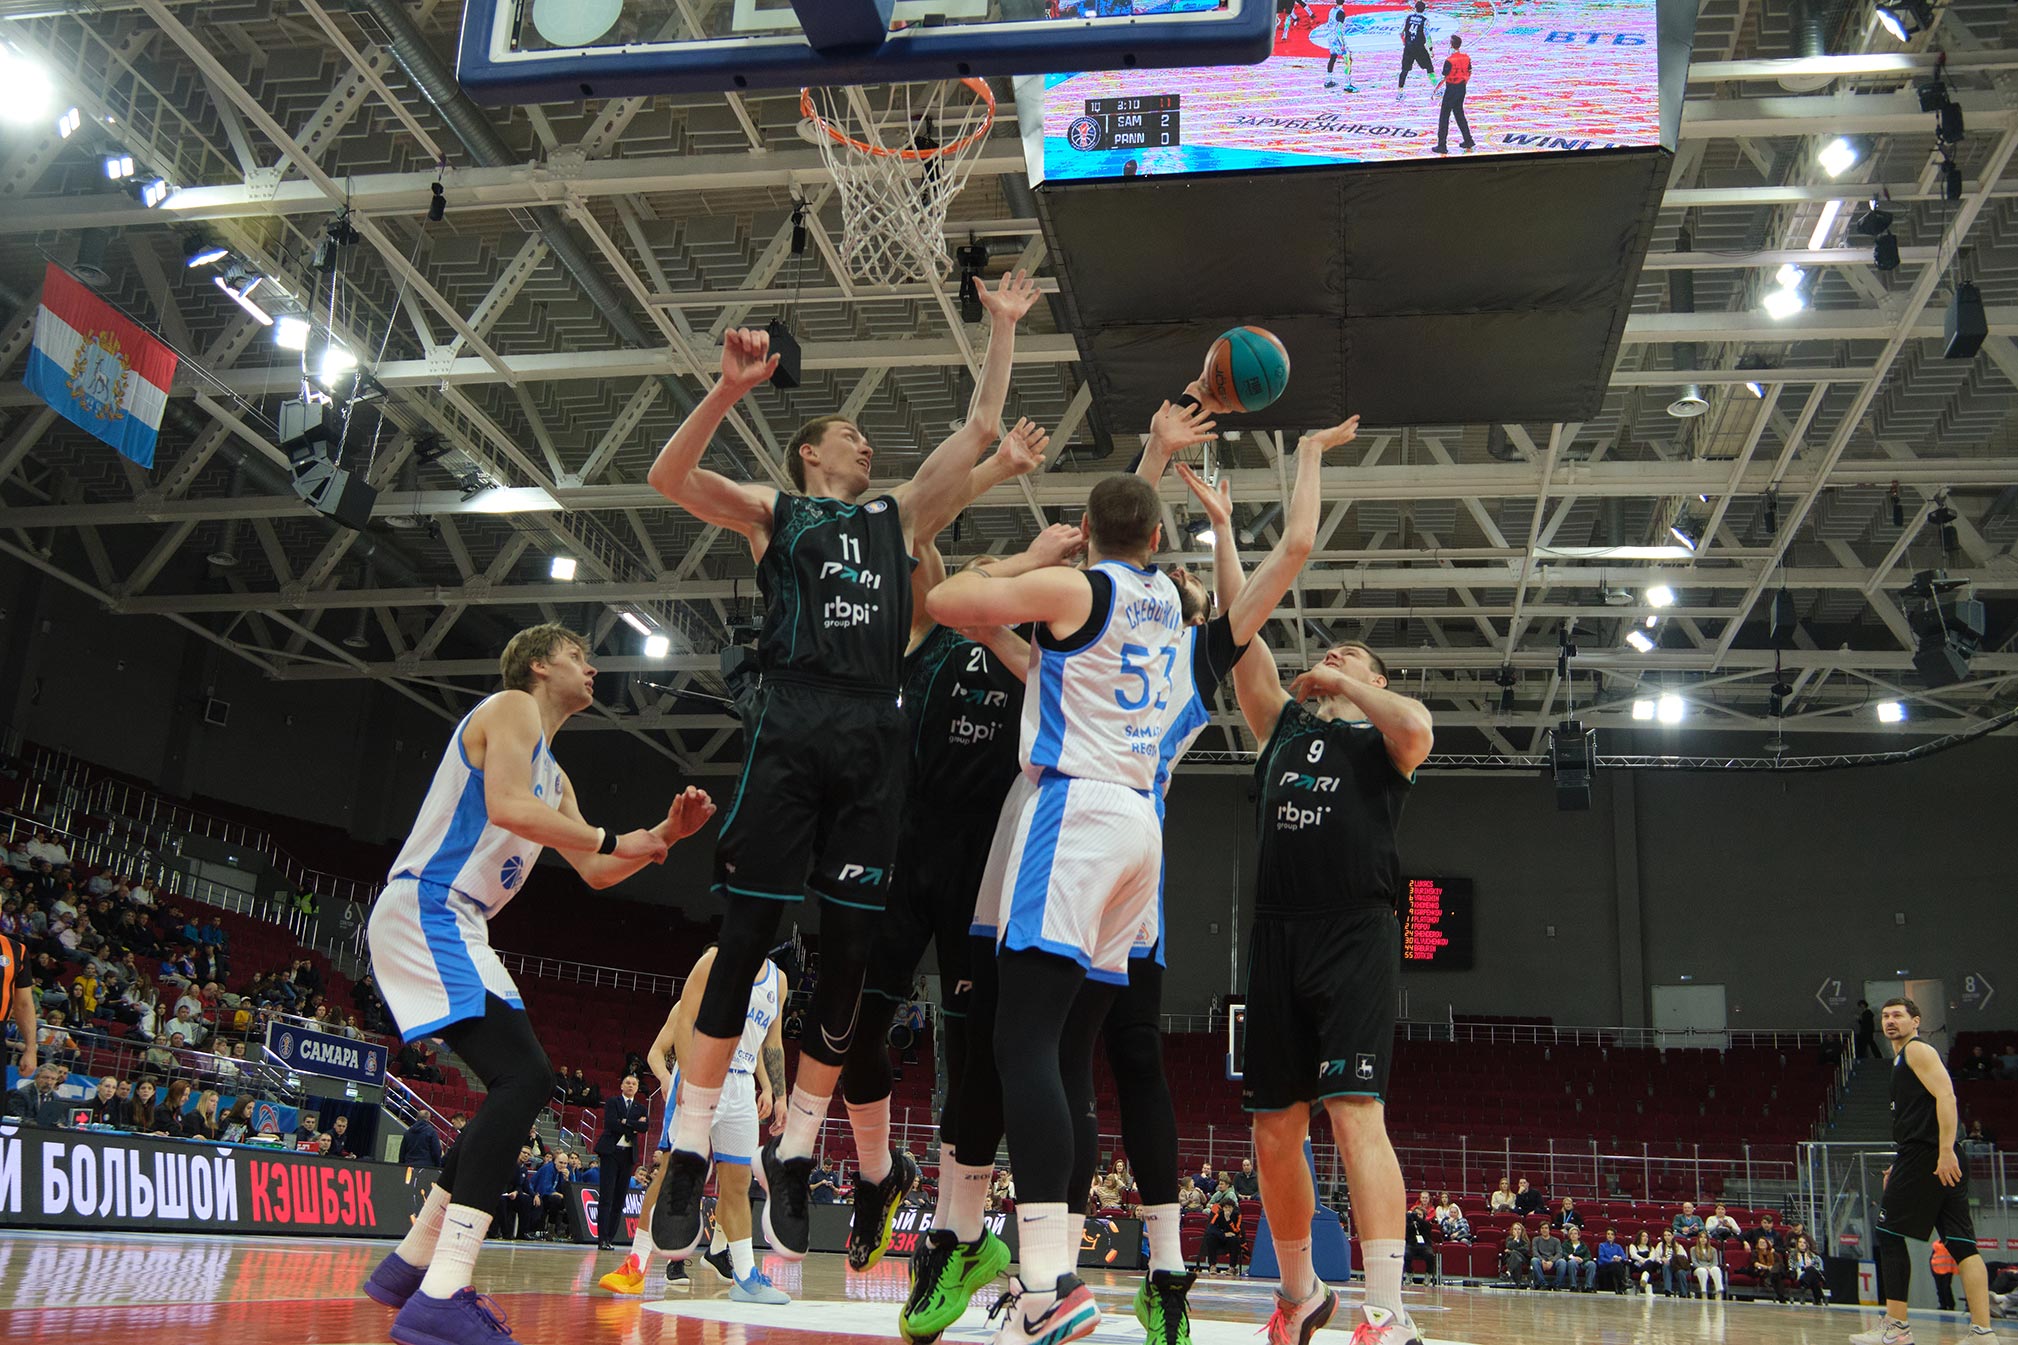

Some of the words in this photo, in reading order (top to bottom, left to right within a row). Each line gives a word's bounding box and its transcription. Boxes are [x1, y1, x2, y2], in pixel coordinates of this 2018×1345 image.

[1544, 31, 1646, 45] ВТБ
[1118, 115, 1142, 127] SAM
[1161, 115, 1170, 127] 2
[1228, 114, 1418, 138] ЗАРУБЕЖНЕФТЬ
[1161, 132, 1170, 145] 0
[839, 533, 861, 564] 11
[820, 562, 881, 590] PARI
[824, 595, 872, 626] rbpi
[824, 619, 851, 628] group
[966, 646, 988, 674] 21
[1115, 642, 1177, 711] 53
[1306, 739, 1325, 763] 9
[1279, 771, 1340, 792] PARI
[1277, 801, 1325, 829] rbpi
[1277, 822, 1298, 831] group
[345, 904, 353, 920] 6
[1832, 980, 1841, 996] 7
[1965, 975, 1975, 992] 8
[746, 1007, 771, 1030] ARA
[300, 1040, 359, 1069] САМАРА
[43, 1142, 239, 1222] БОЛЬШОЙ
[250, 1160, 376, 1226] КЭШБЭК
